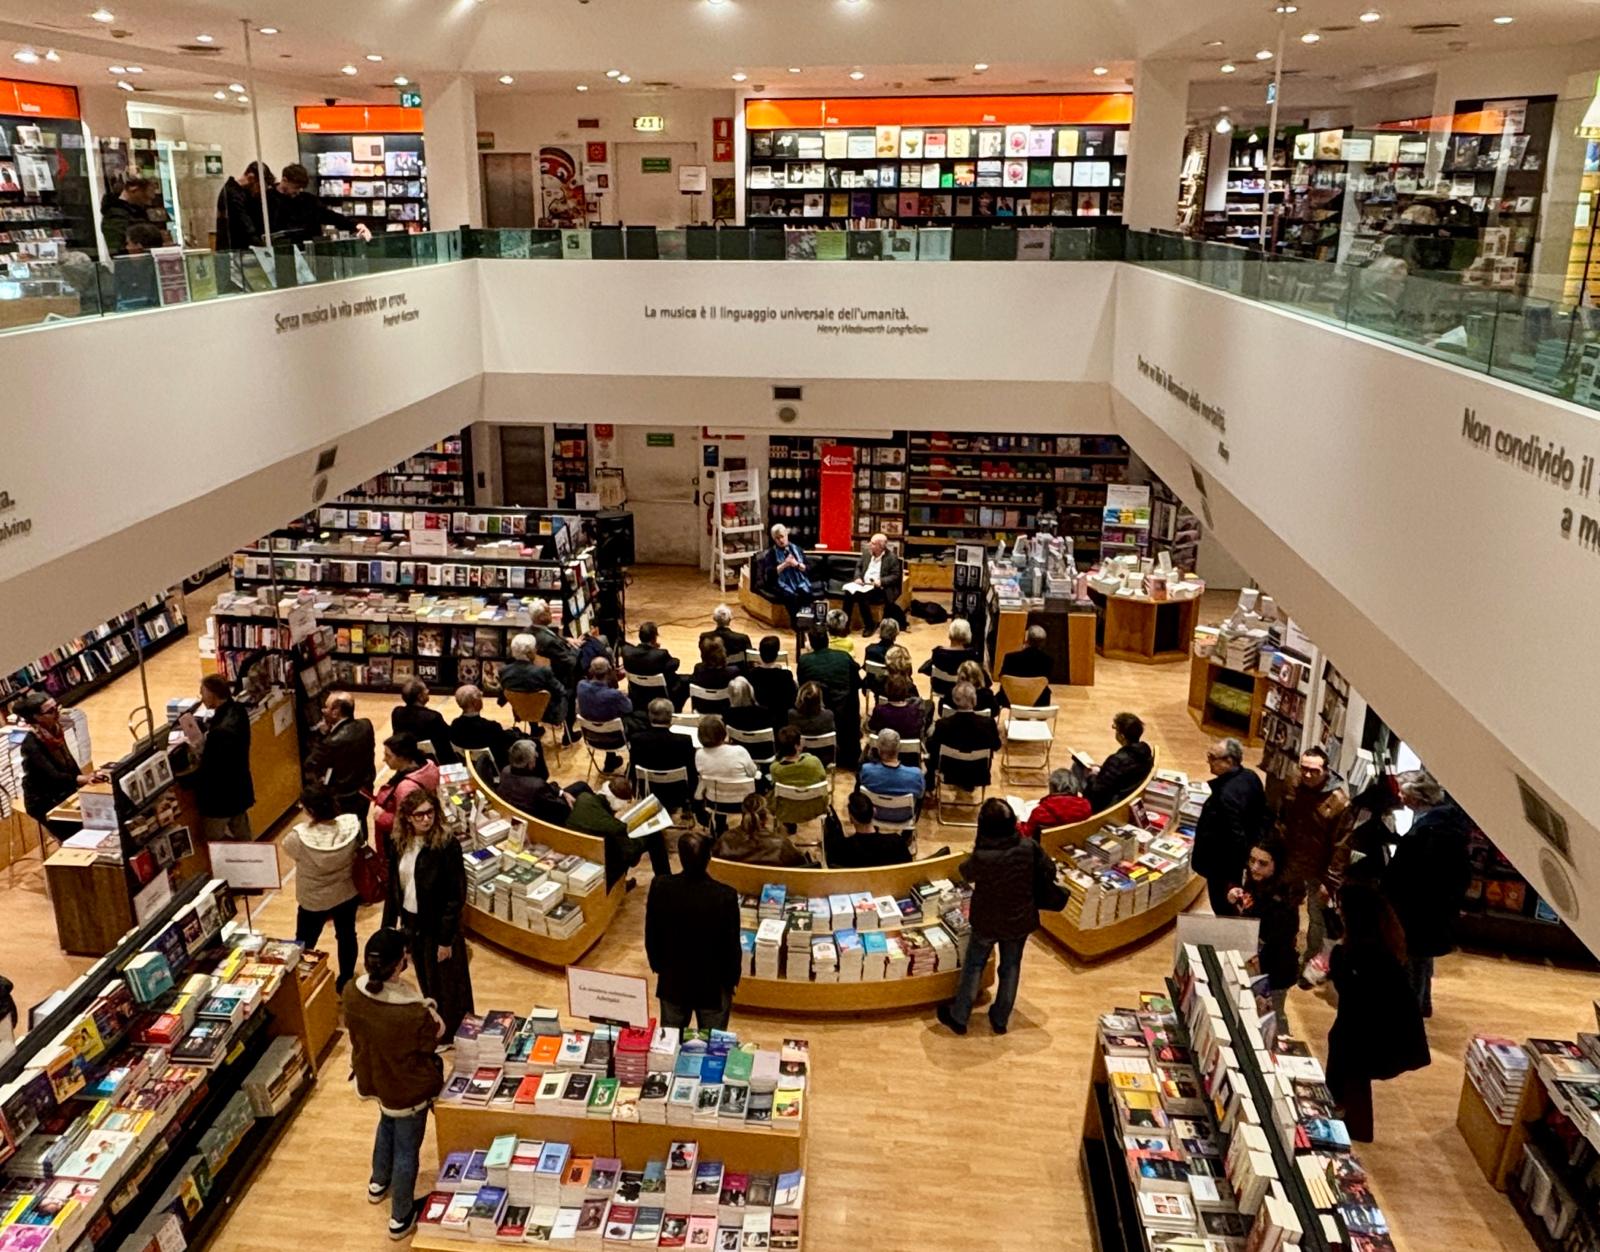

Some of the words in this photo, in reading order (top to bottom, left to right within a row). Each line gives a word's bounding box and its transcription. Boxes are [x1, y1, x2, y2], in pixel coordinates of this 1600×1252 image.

[274, 312, 300, 334] Senza
[302, 305, 329, 325] musica
[329, 303, 338, 319] la
[339, 300, 352, 318] vita
[644, 305, 657, 318] La
[660, 305, 697, 319] musica
[700, 305, 707, 319] è
[720, 306, 777, 322] linguaggio
[780, 307, 835, 320] universale
[817, 324, 841, 336] Henry
[1462, 407, 1491, 448] Non
[1495, 430, 1575, 483] condivido
[1579, 455, 1594, 491] il
[1561, 507, 1573, 532] a
[1579, 514, 1600, 548] m
